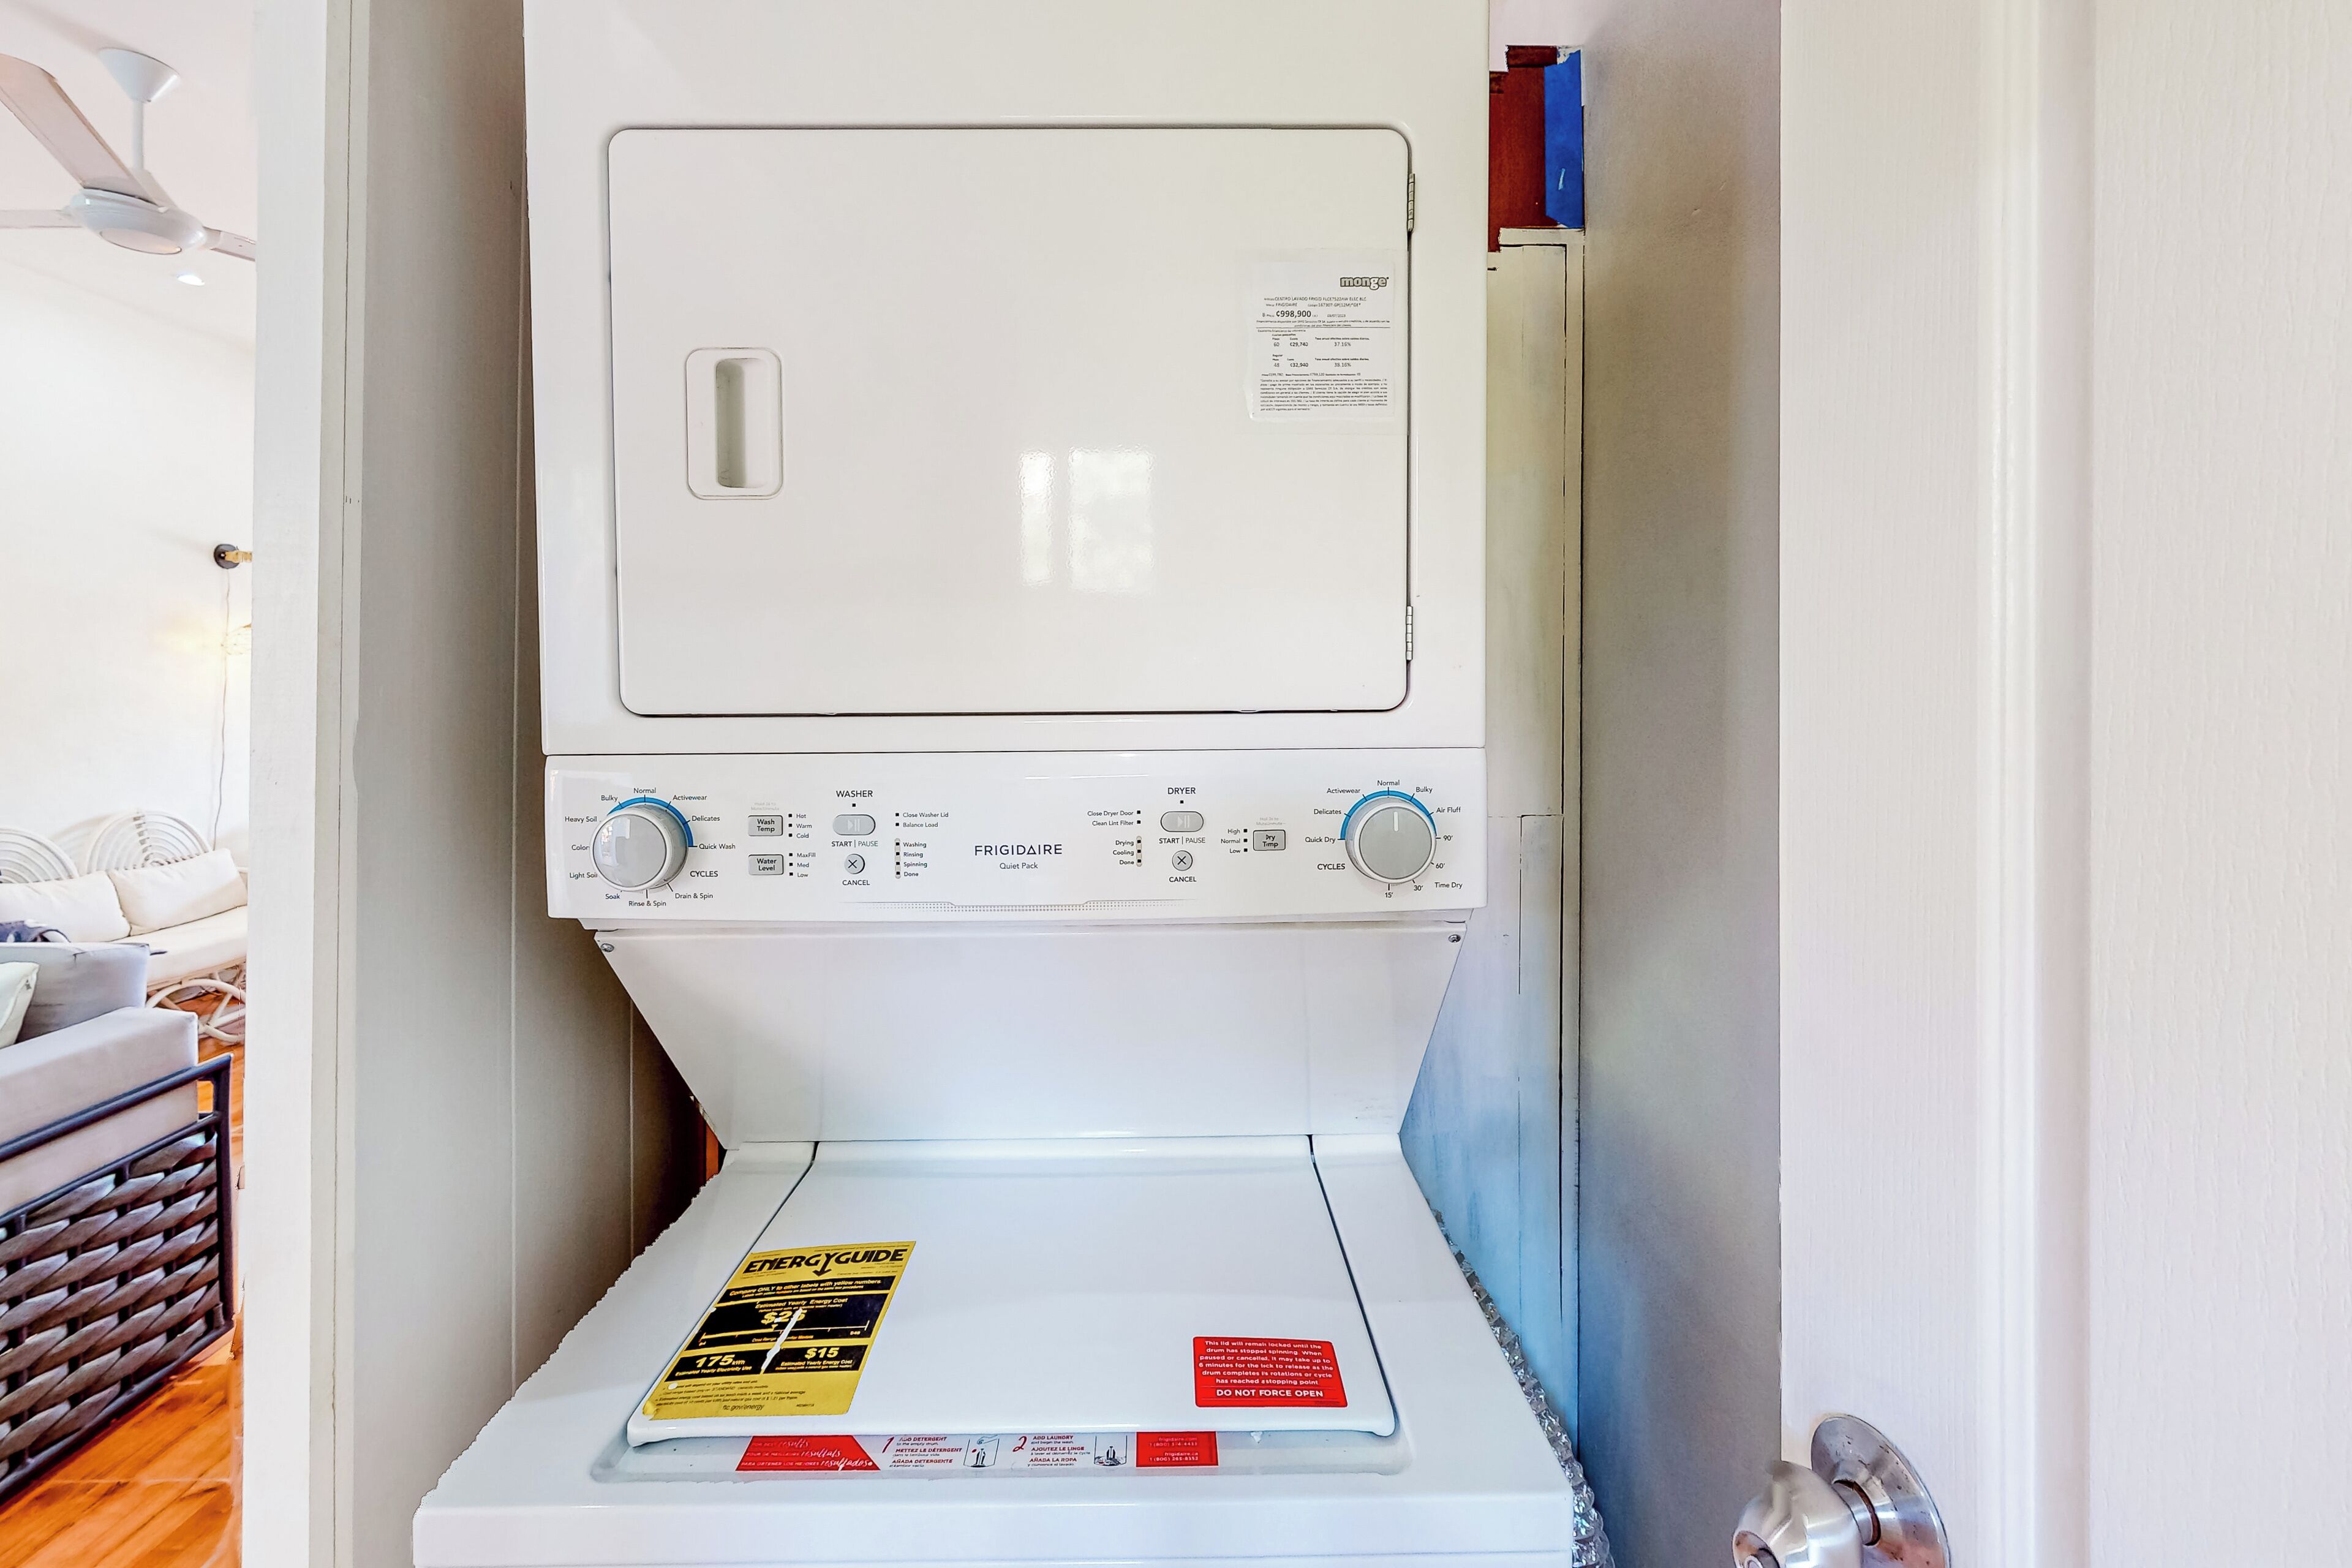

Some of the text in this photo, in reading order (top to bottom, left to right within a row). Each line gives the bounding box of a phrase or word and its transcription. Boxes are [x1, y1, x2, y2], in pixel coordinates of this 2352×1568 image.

[1340, 277, 1387, 290] monge
[975, 844, 1062, 856] FRIGIDAIRE
[743, 1248, 907, 1276] ENERGYGUIDE
[805, 1348, 840, 1359] $15
[696, 1355, 735, 1367] 175
[1012, 1436, 1027, 1452] 2
